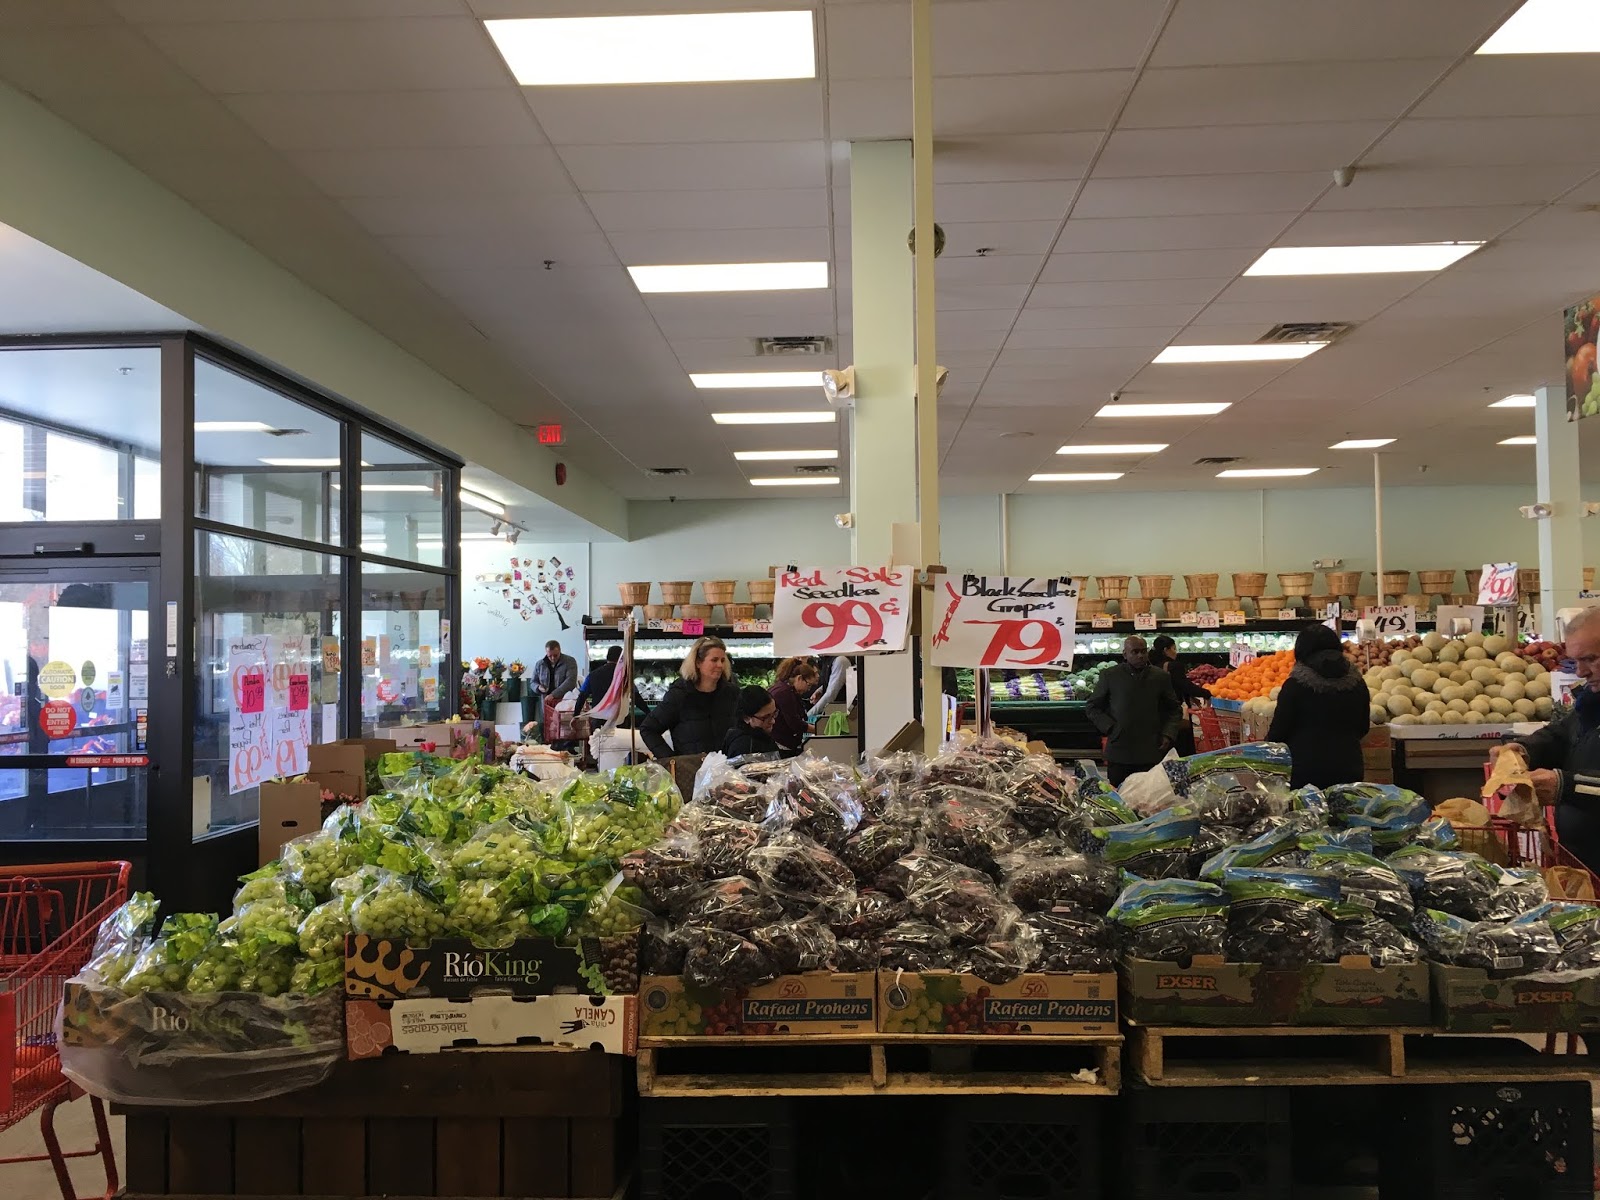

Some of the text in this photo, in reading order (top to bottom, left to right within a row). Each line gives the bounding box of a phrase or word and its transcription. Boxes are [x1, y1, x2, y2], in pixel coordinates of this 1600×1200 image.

[539, 425, 561, 443] EXIT
[781, 570, 827, 587] Red
[962, 575, 1016, 597] Black
[793, 582, 880, 599] Seedless
[987, 598, 1055, 618] Grapes
[962, 619, 1062, 666] 79
[1159, 976, 1215, 989] EXSER
[1519, 991, 1574, 1003] EXSER
[575, 1006, 615, 1024] CANELA
[747, 1001, 868, 1017] Rafael Prohens
[989, 1001, 1112, 1017] Rafael Prohens
[402, 1024, 468, 1035] Table Grapes
